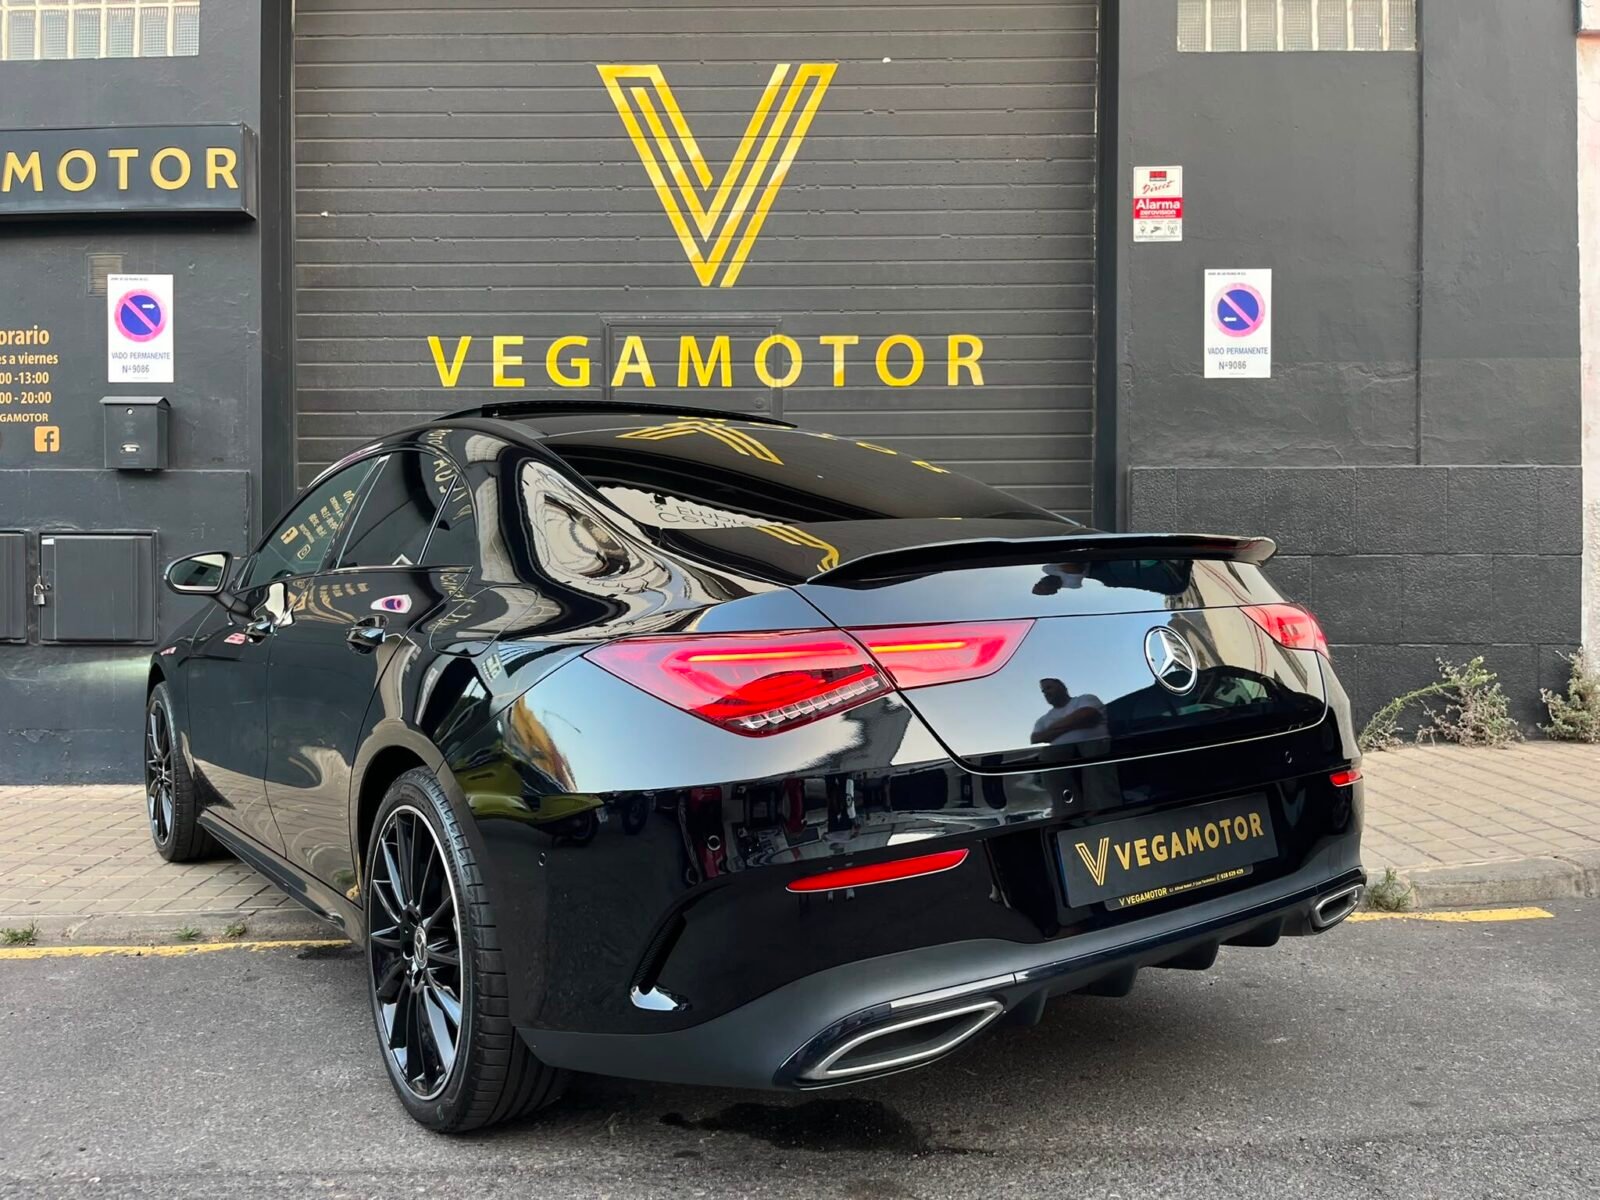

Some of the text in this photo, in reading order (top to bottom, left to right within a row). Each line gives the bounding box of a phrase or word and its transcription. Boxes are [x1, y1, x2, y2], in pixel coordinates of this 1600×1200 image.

[1, 147, 239, 193] MOTOR
[1136, 199, 1181, 210] Alarma
[111, 352, 171, 360] VADO PERMANENTE
[1207, 347, 1269, 355] VADO PERMANENTE
[9, 355, 16, 365] a
[18, 352, 59, 365] viernes
[426, 333, 986, 390] VEGAMOTOR
[20, 392, 52, 404] 20:00
[1114, 812, 1264, 870] VEGAMOTOR
[1127, 887, 1167, 904] VEGAMOTOR
